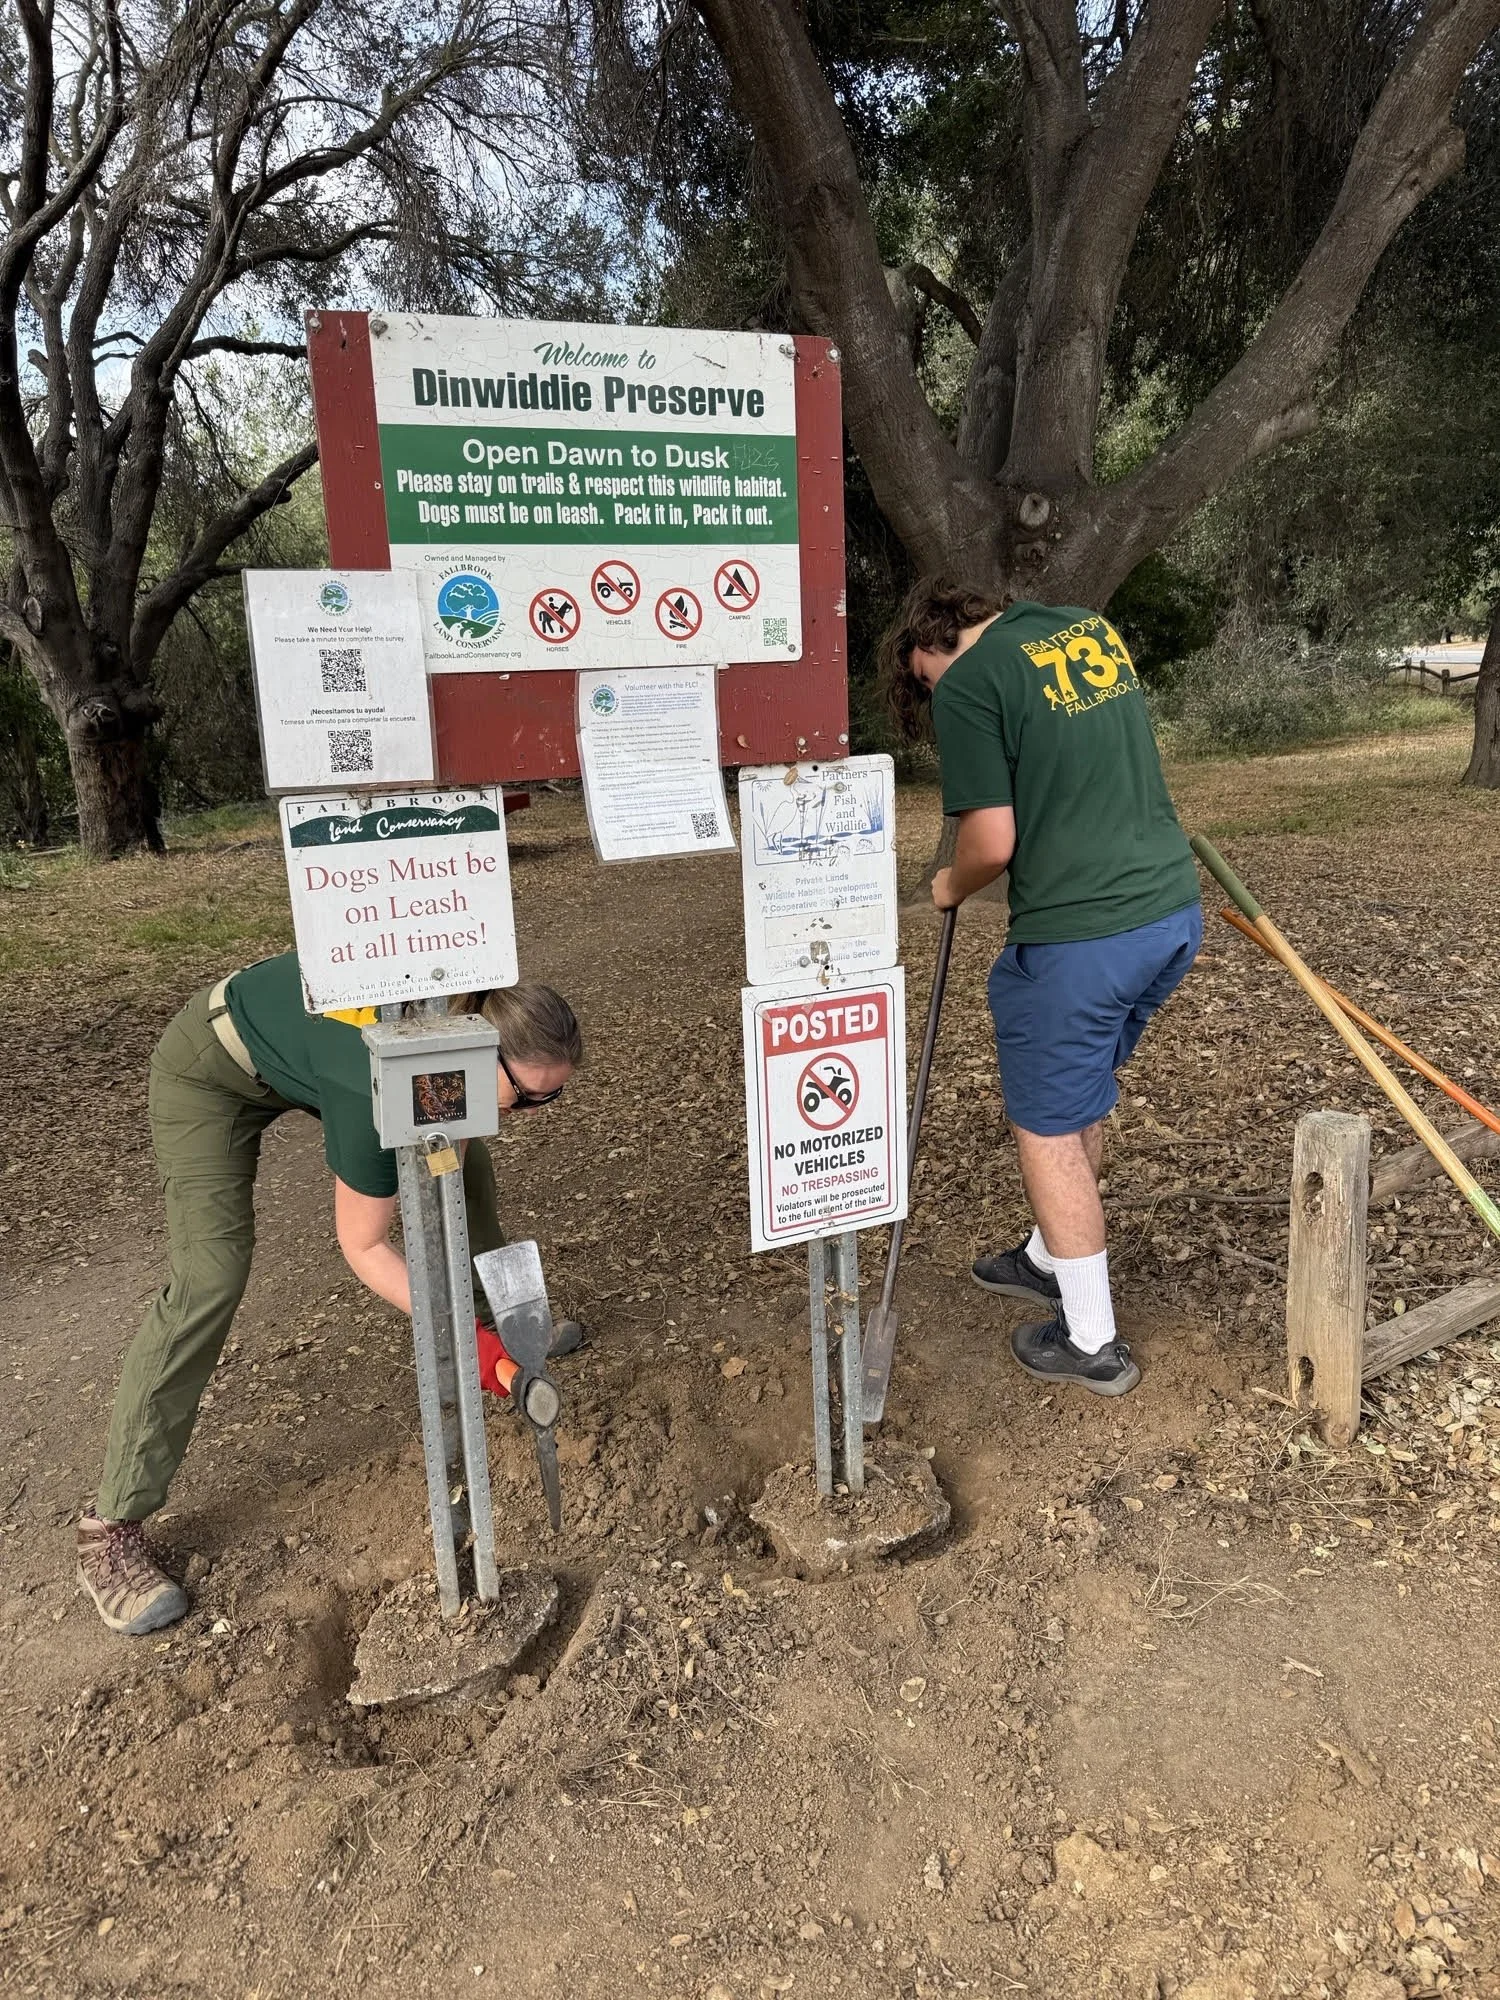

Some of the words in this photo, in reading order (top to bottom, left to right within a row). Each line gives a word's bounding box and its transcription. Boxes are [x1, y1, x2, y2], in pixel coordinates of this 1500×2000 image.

[533, 341, 629, 369] Welcome
[638, 349, 656, 369] to
[412, 367, 592, 412] Dinwiddie
[604, 376, 764, 418] Preserve
[462, 438, 539, 470] Open
[547, 441, 623, 466] Dawn
[630, 445, 657, 467] to
[665, 444, 730, 469] Dusk
[396, 469, 453, 493] Please
[457, 471, 492, 497] stay
[497, 475, 517, 494] on
[521, 472, 564, 495] trails
[568, 472, 581, 495] &
[585, 475, 644, 498] respect
[648, 474, 675, 497] this
[679, 475, 731, 497] wildlife
[734, 476, 787, 498] habitat.
[418, 500, 460, 527] Dogs
[464, 502, 505, 524] must
[509, 501, 529, 524] be
[533, 505, 553, 524] on
[556, 502, 604, 525] leash.
[614, 502, 651, 525] Pack
[655, 503, 666, 525] it
[669, 503, 688, 529] in,
[693, 503, 728, 525] Pack
[732, 504, 742, 525] it
[745, 505, 773, 526] out.
[424, 554, 449, 562] Owned
[465, 555, 496, 563] Managed
[498, 555, 506, 563] by
[438, 563, 494, 581] FALLBROOK
[355, 626, 372, 634] Help!
[433, 621, 453, 642] LAND
[455, 620, 506, 649] CONSERVANCY
[1020, 640, 1055, 656] BSA
[1048, 617, 1099, 647] TROOP
[624, 683, 656, 691] Volunteer
[658, 682, 672, 690] with
[673, 681, 684, 689] the
[310, 708, 355, 716] ¡Necesitamos
[364, 707, 386, 715] ayuda!
[822, 769, 868, 781] Partners
[296, 791, 490, 815] FALBROOK
[834, 794, 857, 805] Fish
[836, 807, 855, 819] and
[328, 819, 363, 842] Land
[376, 815, 466, 838] Conservancy
[826, 820, 867, 832] Wildlife
[304, 865, 379, 893] Dogs
[388, 852, 458, 882] Must
[465, 849, 497, 875] be
[795, 877, 823, 886] Private
[825, 873, 849, 882] Lands
[765, 890, 796, 901] Wildlife
[828, 881, 878, 894] Development
[770, 901, 818, 913] Cooperative
[850, 893, 883, 903] Between
[345, 903, 379, 925] on
[388, 889, 468, 920] Leash
[331, 941, 355, 964] at
[365, 932, 398, 960] all
[407, 922, 487, 954] times!
[853, 950, 881, 959] Service
[369, 990, 385, 998] and
[388, 986, 414, 996] Leash
[440, 980, 472, 988] Section
[380, 979, 407, 988] Diego
[446, 970, 469, 978] Code
[771, 1002, 879, 1047] POSTED
[774, 1143, 796, 1160] NO
[800, 1125, 884, 1155] MOTORIZED
[794, 1149, 865, 1176] VEHICLES
[781, 1183, 799, 1197] NO
[801, 1167, 879, 1193] TRESPASSING
[776, 1199, 812, 1213] Violators
[814, 1194, 828, 1204] will
[829, 1193, 840, 1202] be
[841, 1183, 885, 1200] prosecuted
[778, 1216, 787, 1224] to
[789, 1212, 802, 1222] the
[803, 1208, 817, 1219] full
[818, 1204, 843, 1215] extent
[844, 1201, 853, 1210] of
[854, 1198, 867, 1207] the
[868, 1195, 884, 1205] law.
